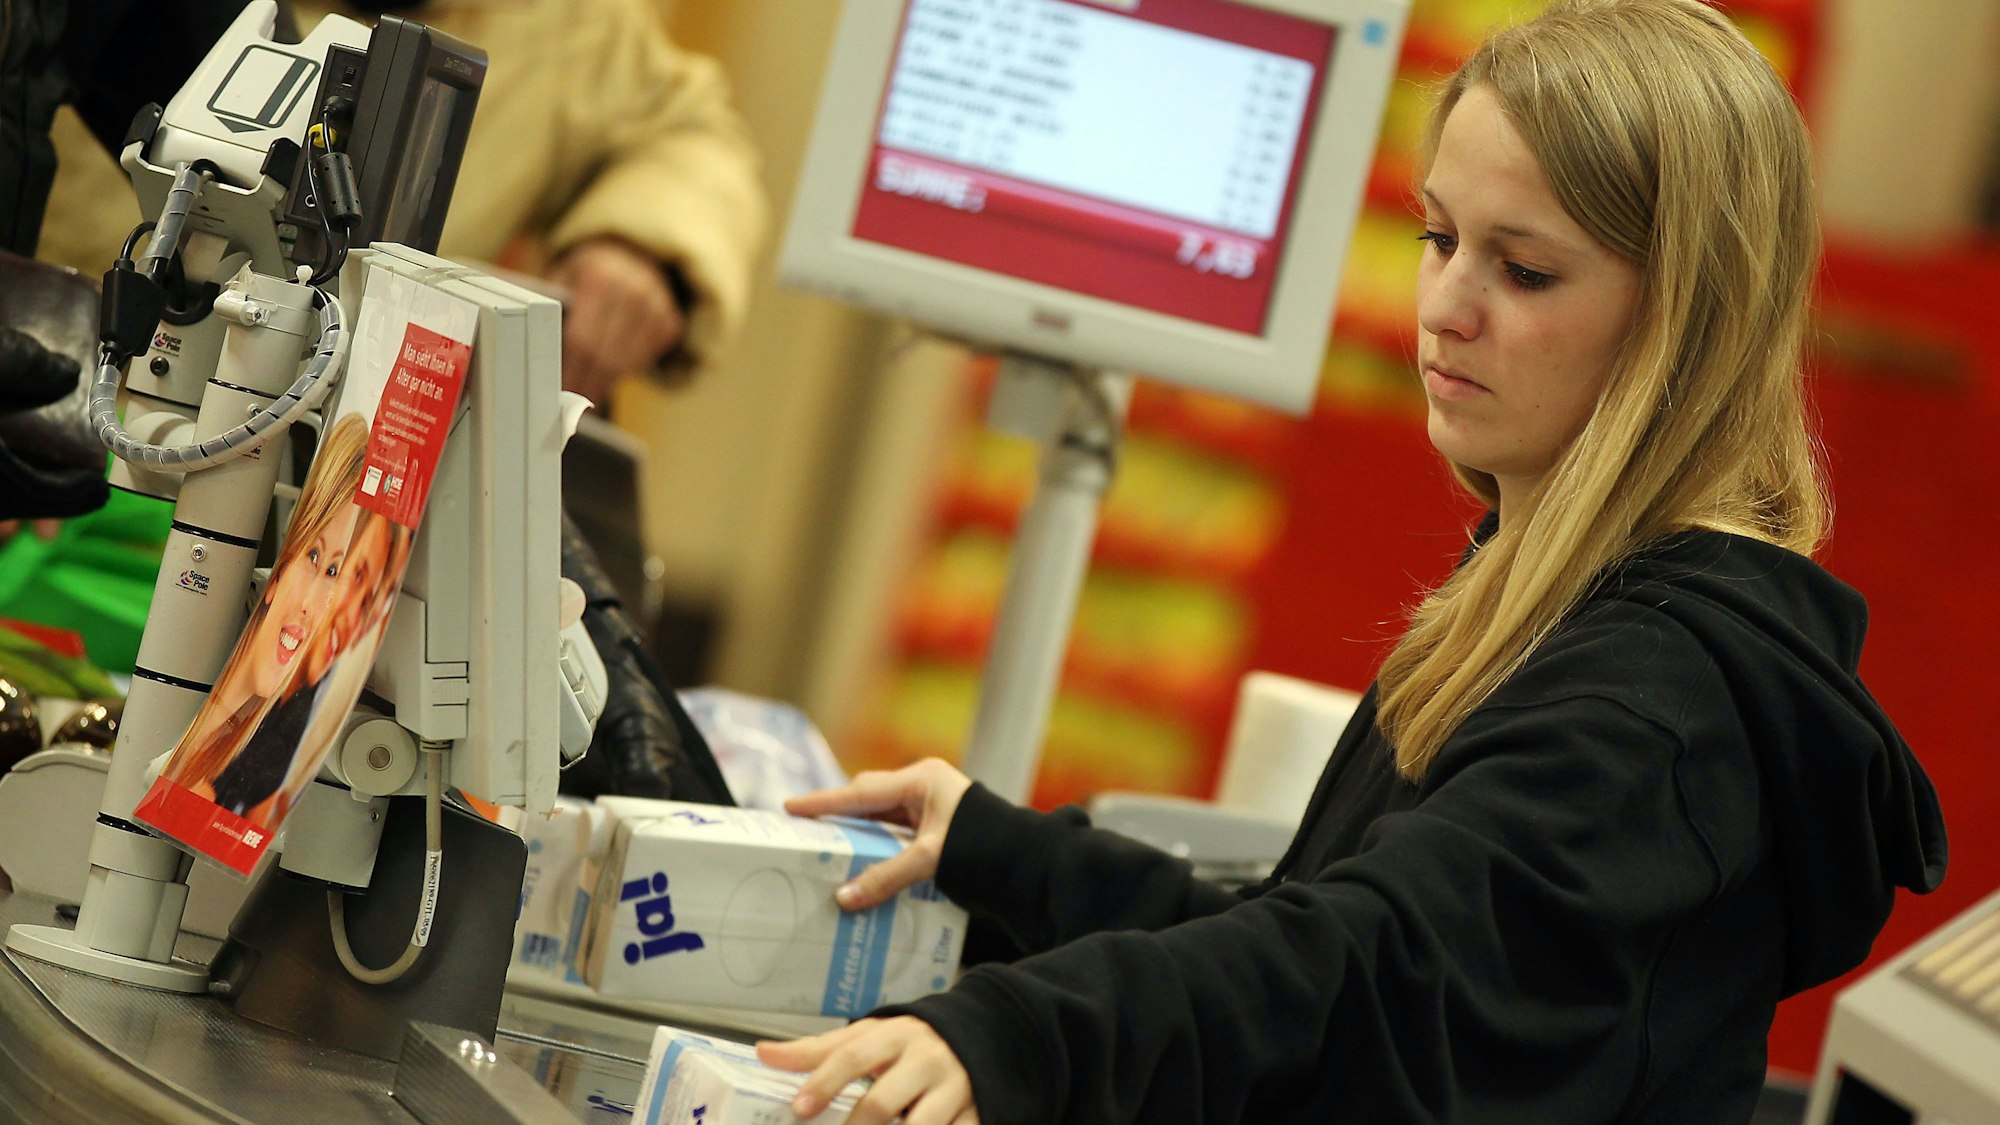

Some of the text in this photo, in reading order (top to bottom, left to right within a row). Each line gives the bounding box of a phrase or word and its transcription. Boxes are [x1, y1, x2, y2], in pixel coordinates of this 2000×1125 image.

[403, 342, 417, 363] Man
[415, 348, 431, 369] sieht
[428, 353, 447, 375] Ihnen
[396, 366, 411, 387] Alter
[408, 376, 421, 394] gar
[419, 377, 436, 398] nicht
[190, 570, 210, 584] Space
[194, 579, 209, 591] Pole
